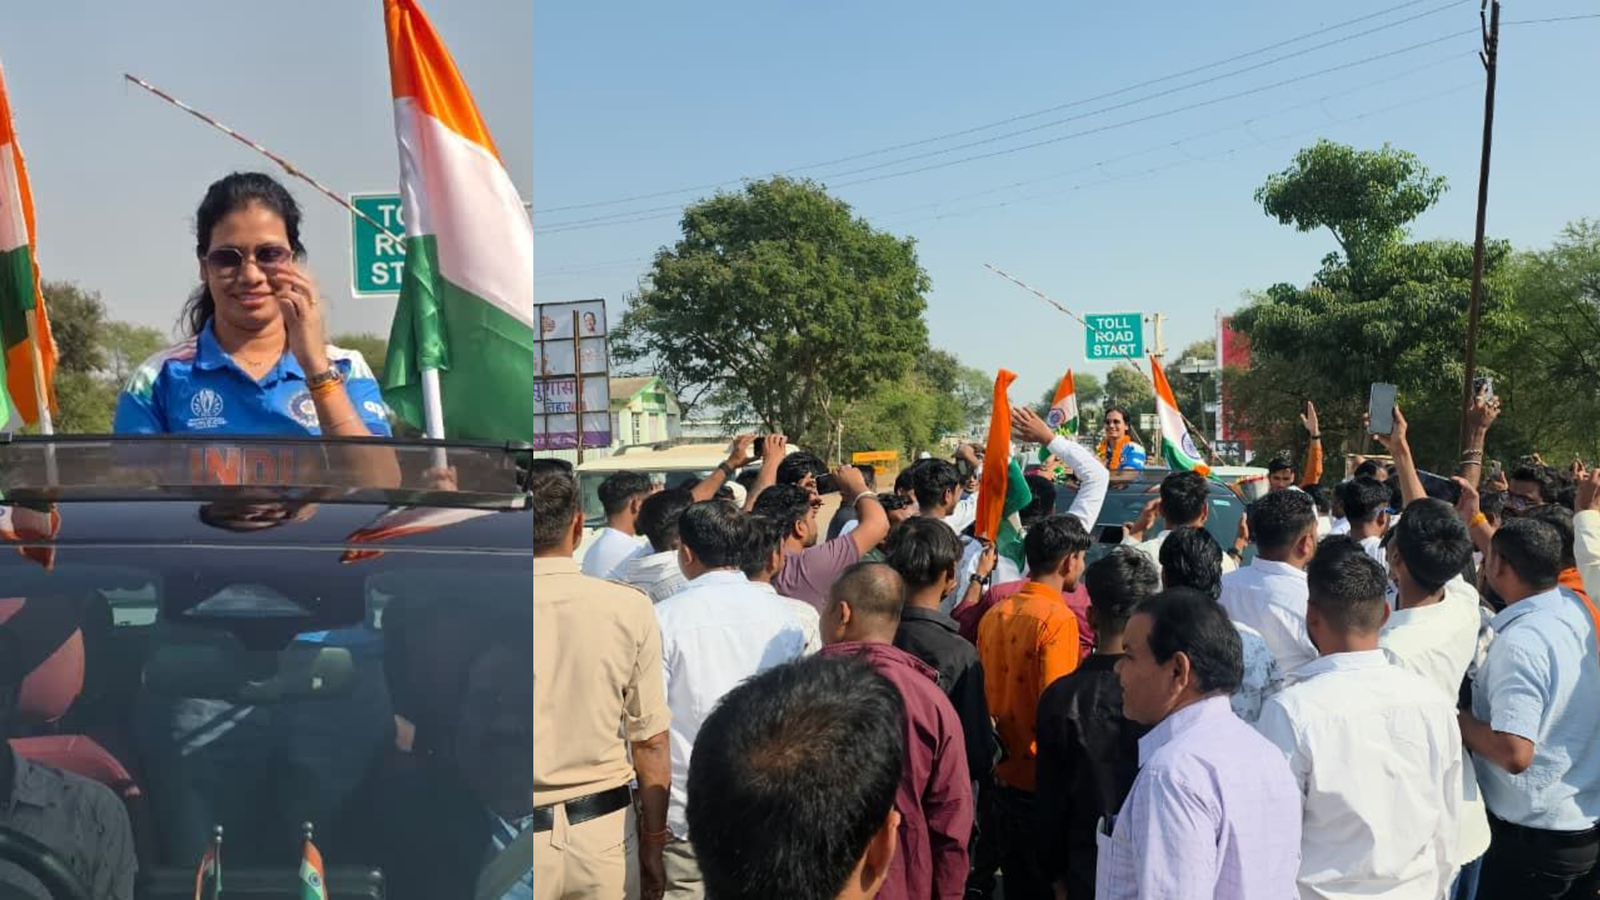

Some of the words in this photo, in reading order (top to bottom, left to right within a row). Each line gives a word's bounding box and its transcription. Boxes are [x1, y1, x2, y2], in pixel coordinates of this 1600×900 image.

[1096, 317, 1131, 329] TOLL
[1094, 331, 1134, 343] ROAD
[1093, 344, 1137, 356] START
